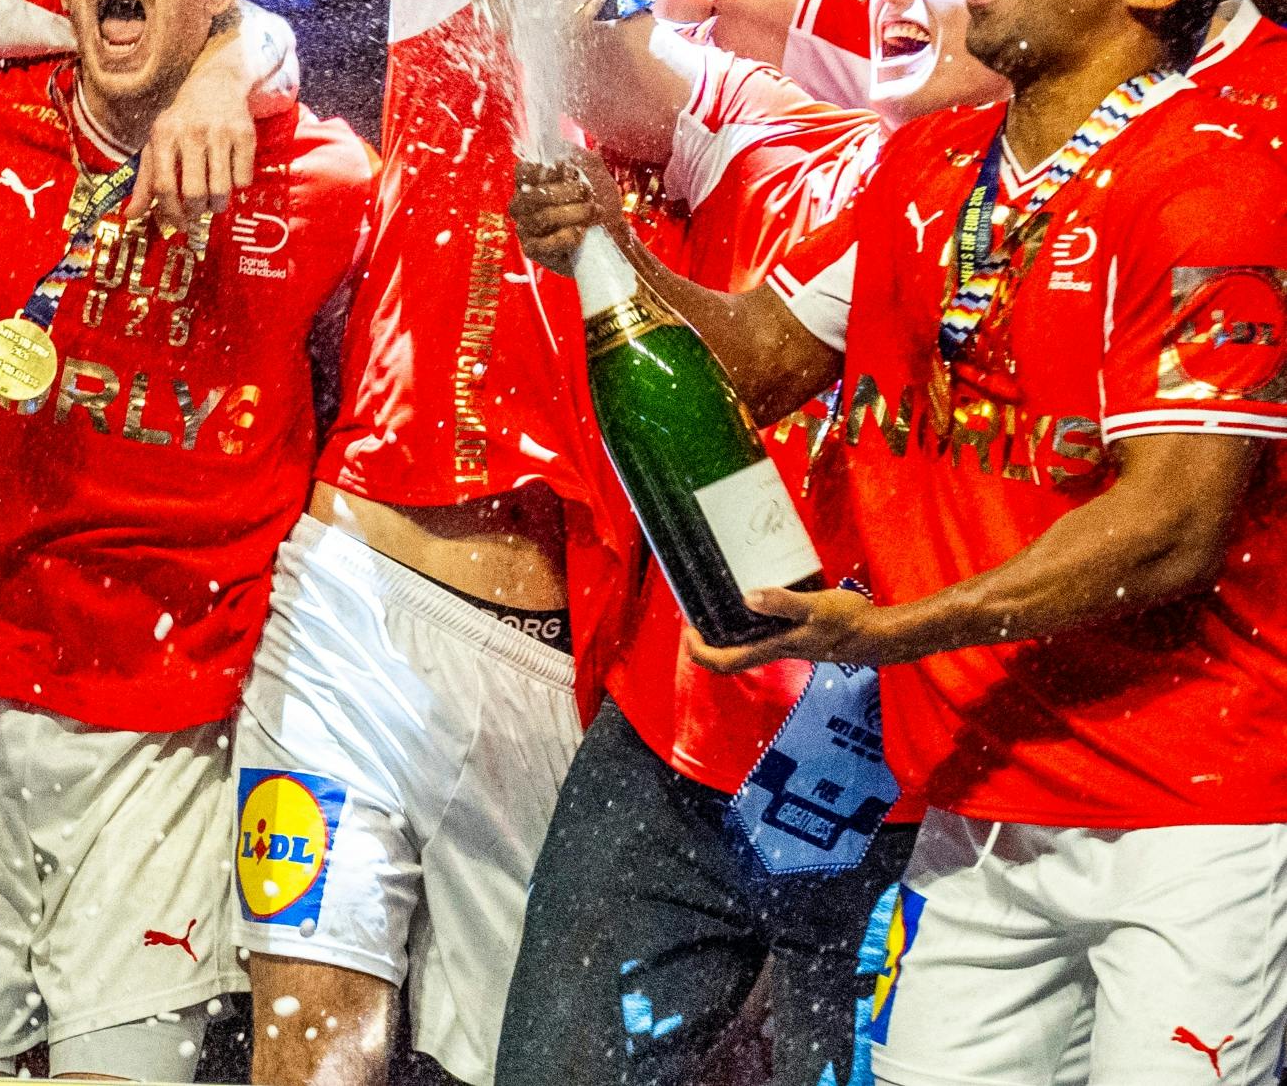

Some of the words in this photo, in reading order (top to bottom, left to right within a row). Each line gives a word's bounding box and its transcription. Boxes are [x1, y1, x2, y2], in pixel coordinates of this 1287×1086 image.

[968, 186, 987, 207] 2026
[962, 206, 981, 232] EURO
[94, 230, 195, 302] ULD
[81, 288, 195, 348] 026
[480, 607, 562, 639] ORG
